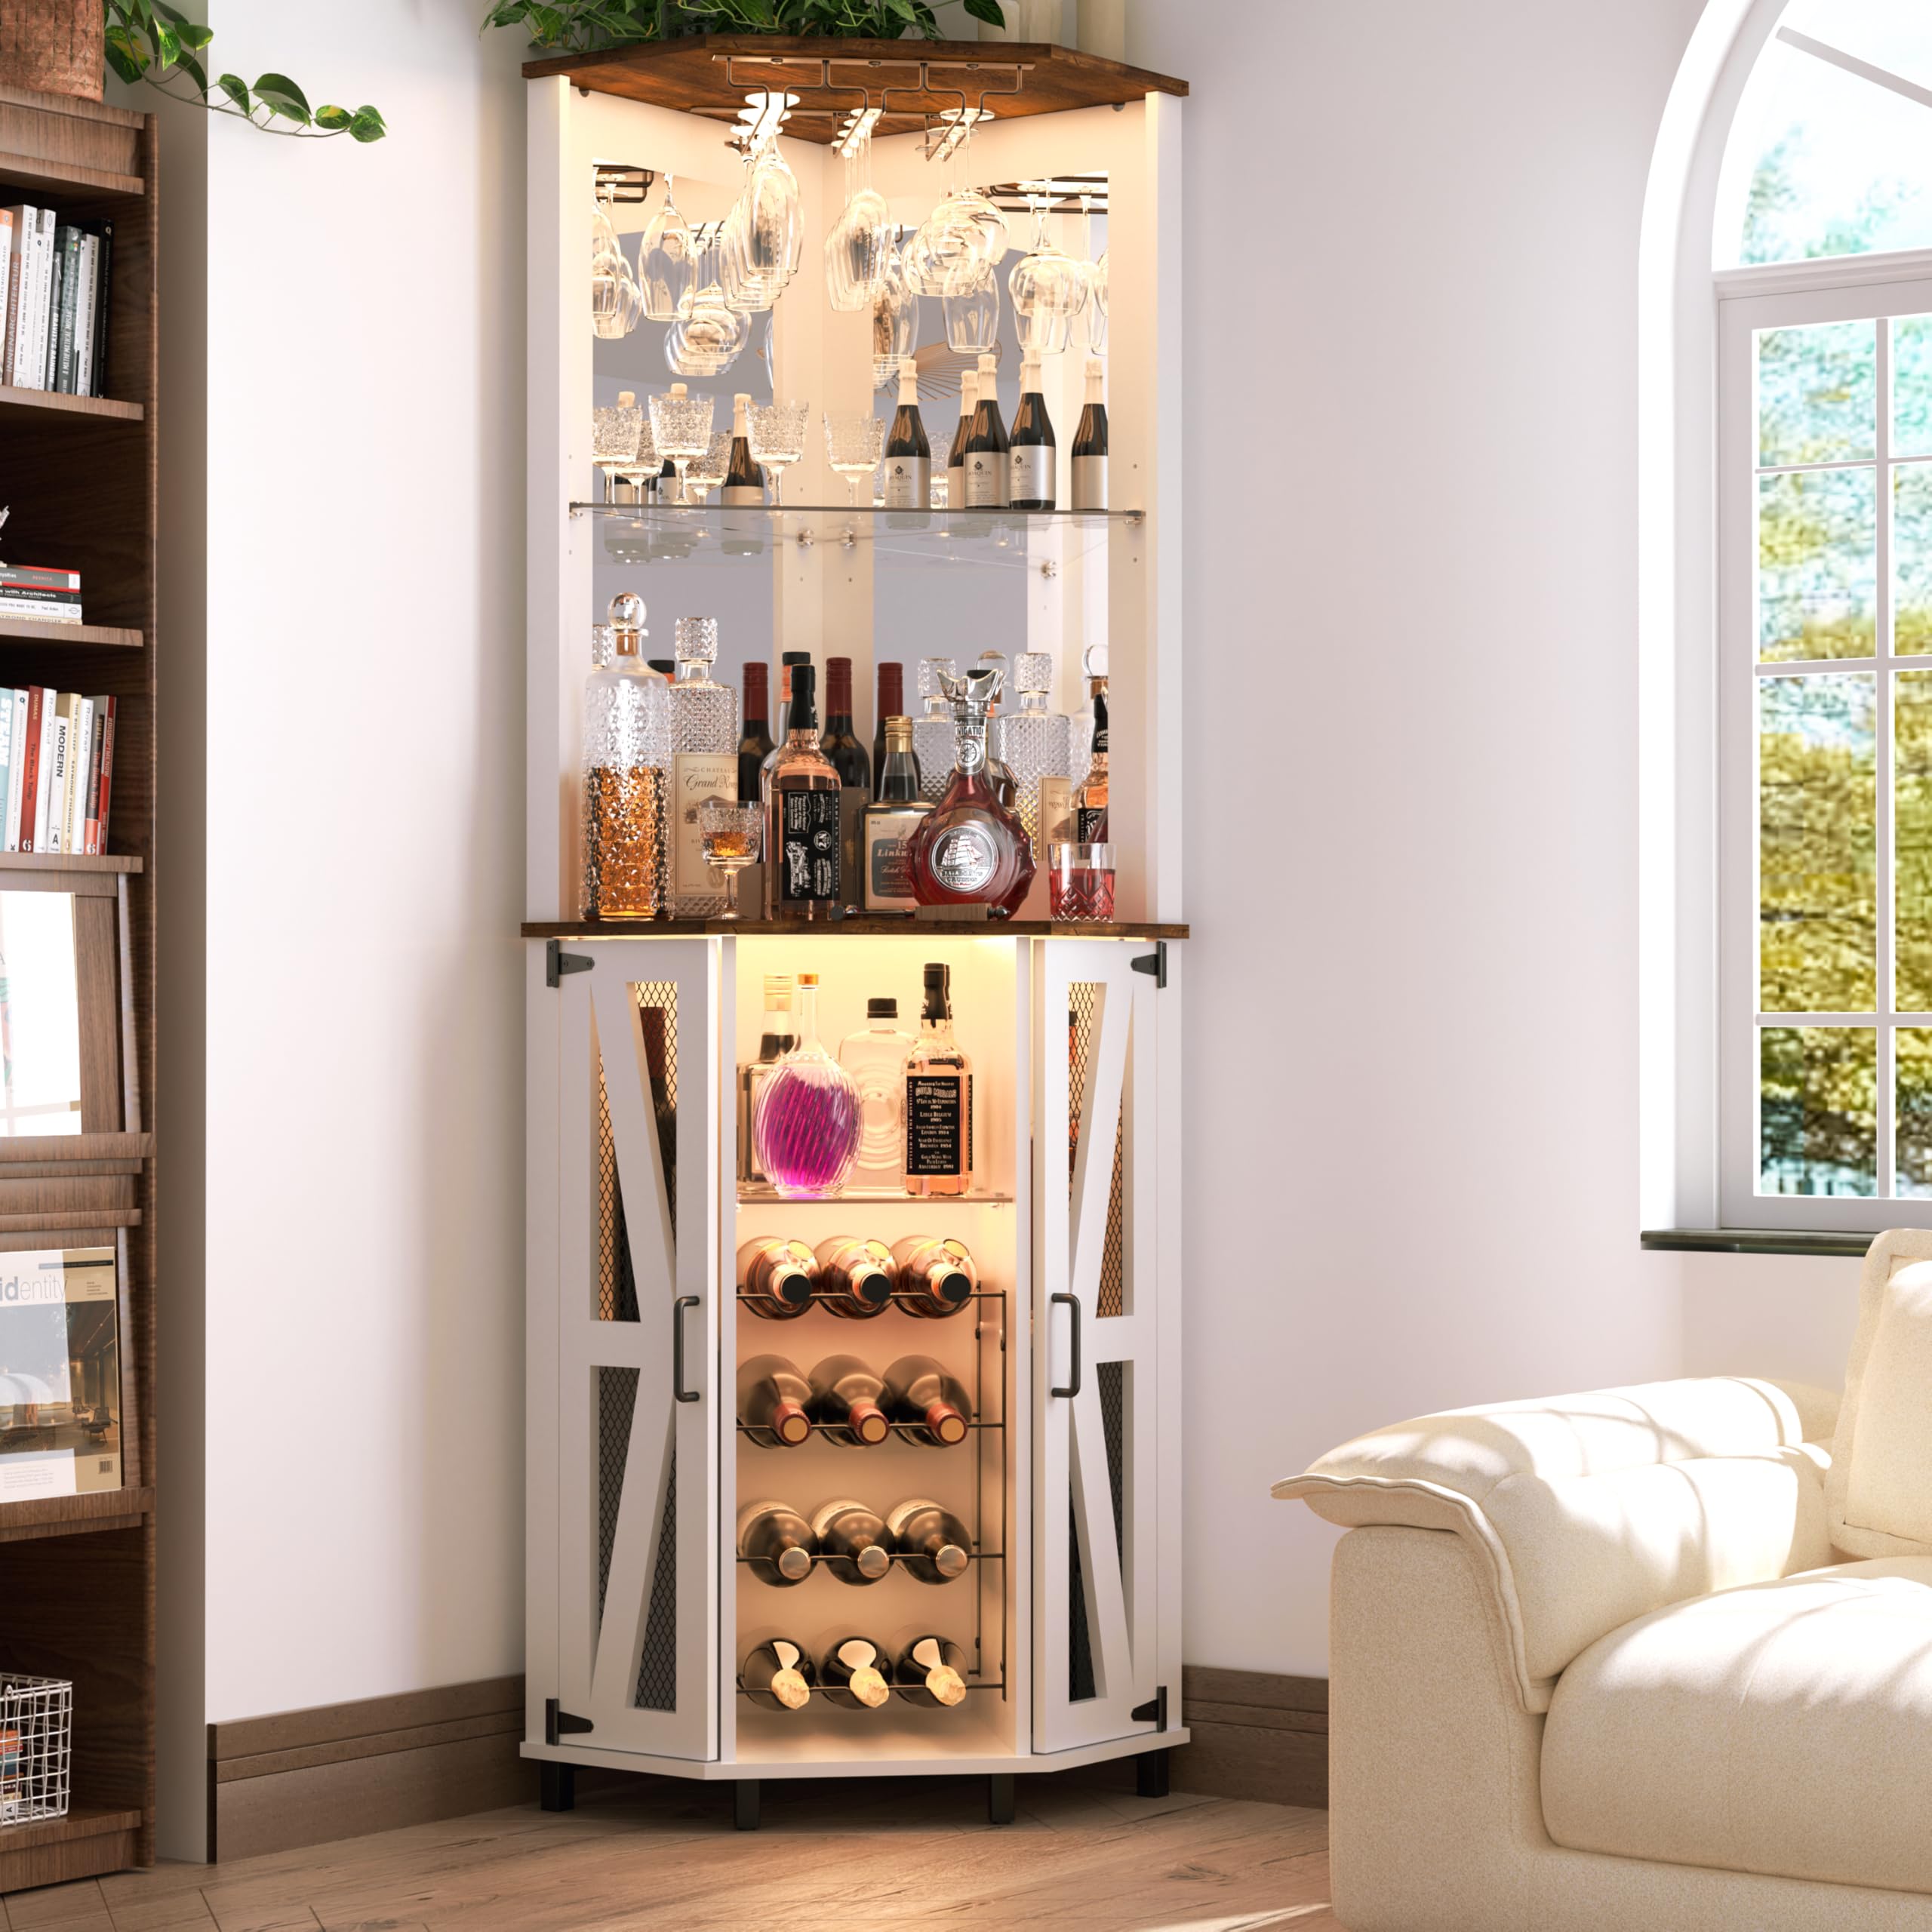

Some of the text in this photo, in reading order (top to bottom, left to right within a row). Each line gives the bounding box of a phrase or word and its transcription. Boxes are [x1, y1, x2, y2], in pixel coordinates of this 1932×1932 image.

[6, 261, 20, 373] INNENARCHITEKTUR
[48, 312, 59, 384] GRAVITY'S RAINBOW
[0, 697, 13, 768] STEAM
[56, 725, 66, 778] MODERN
[104, 717, 112, 778] #DISRUPTMENOW
[90, 790, 98, 809] Tulip
[683, 774, 718, 790] Grand
[897, 841, 907, 850] 15
